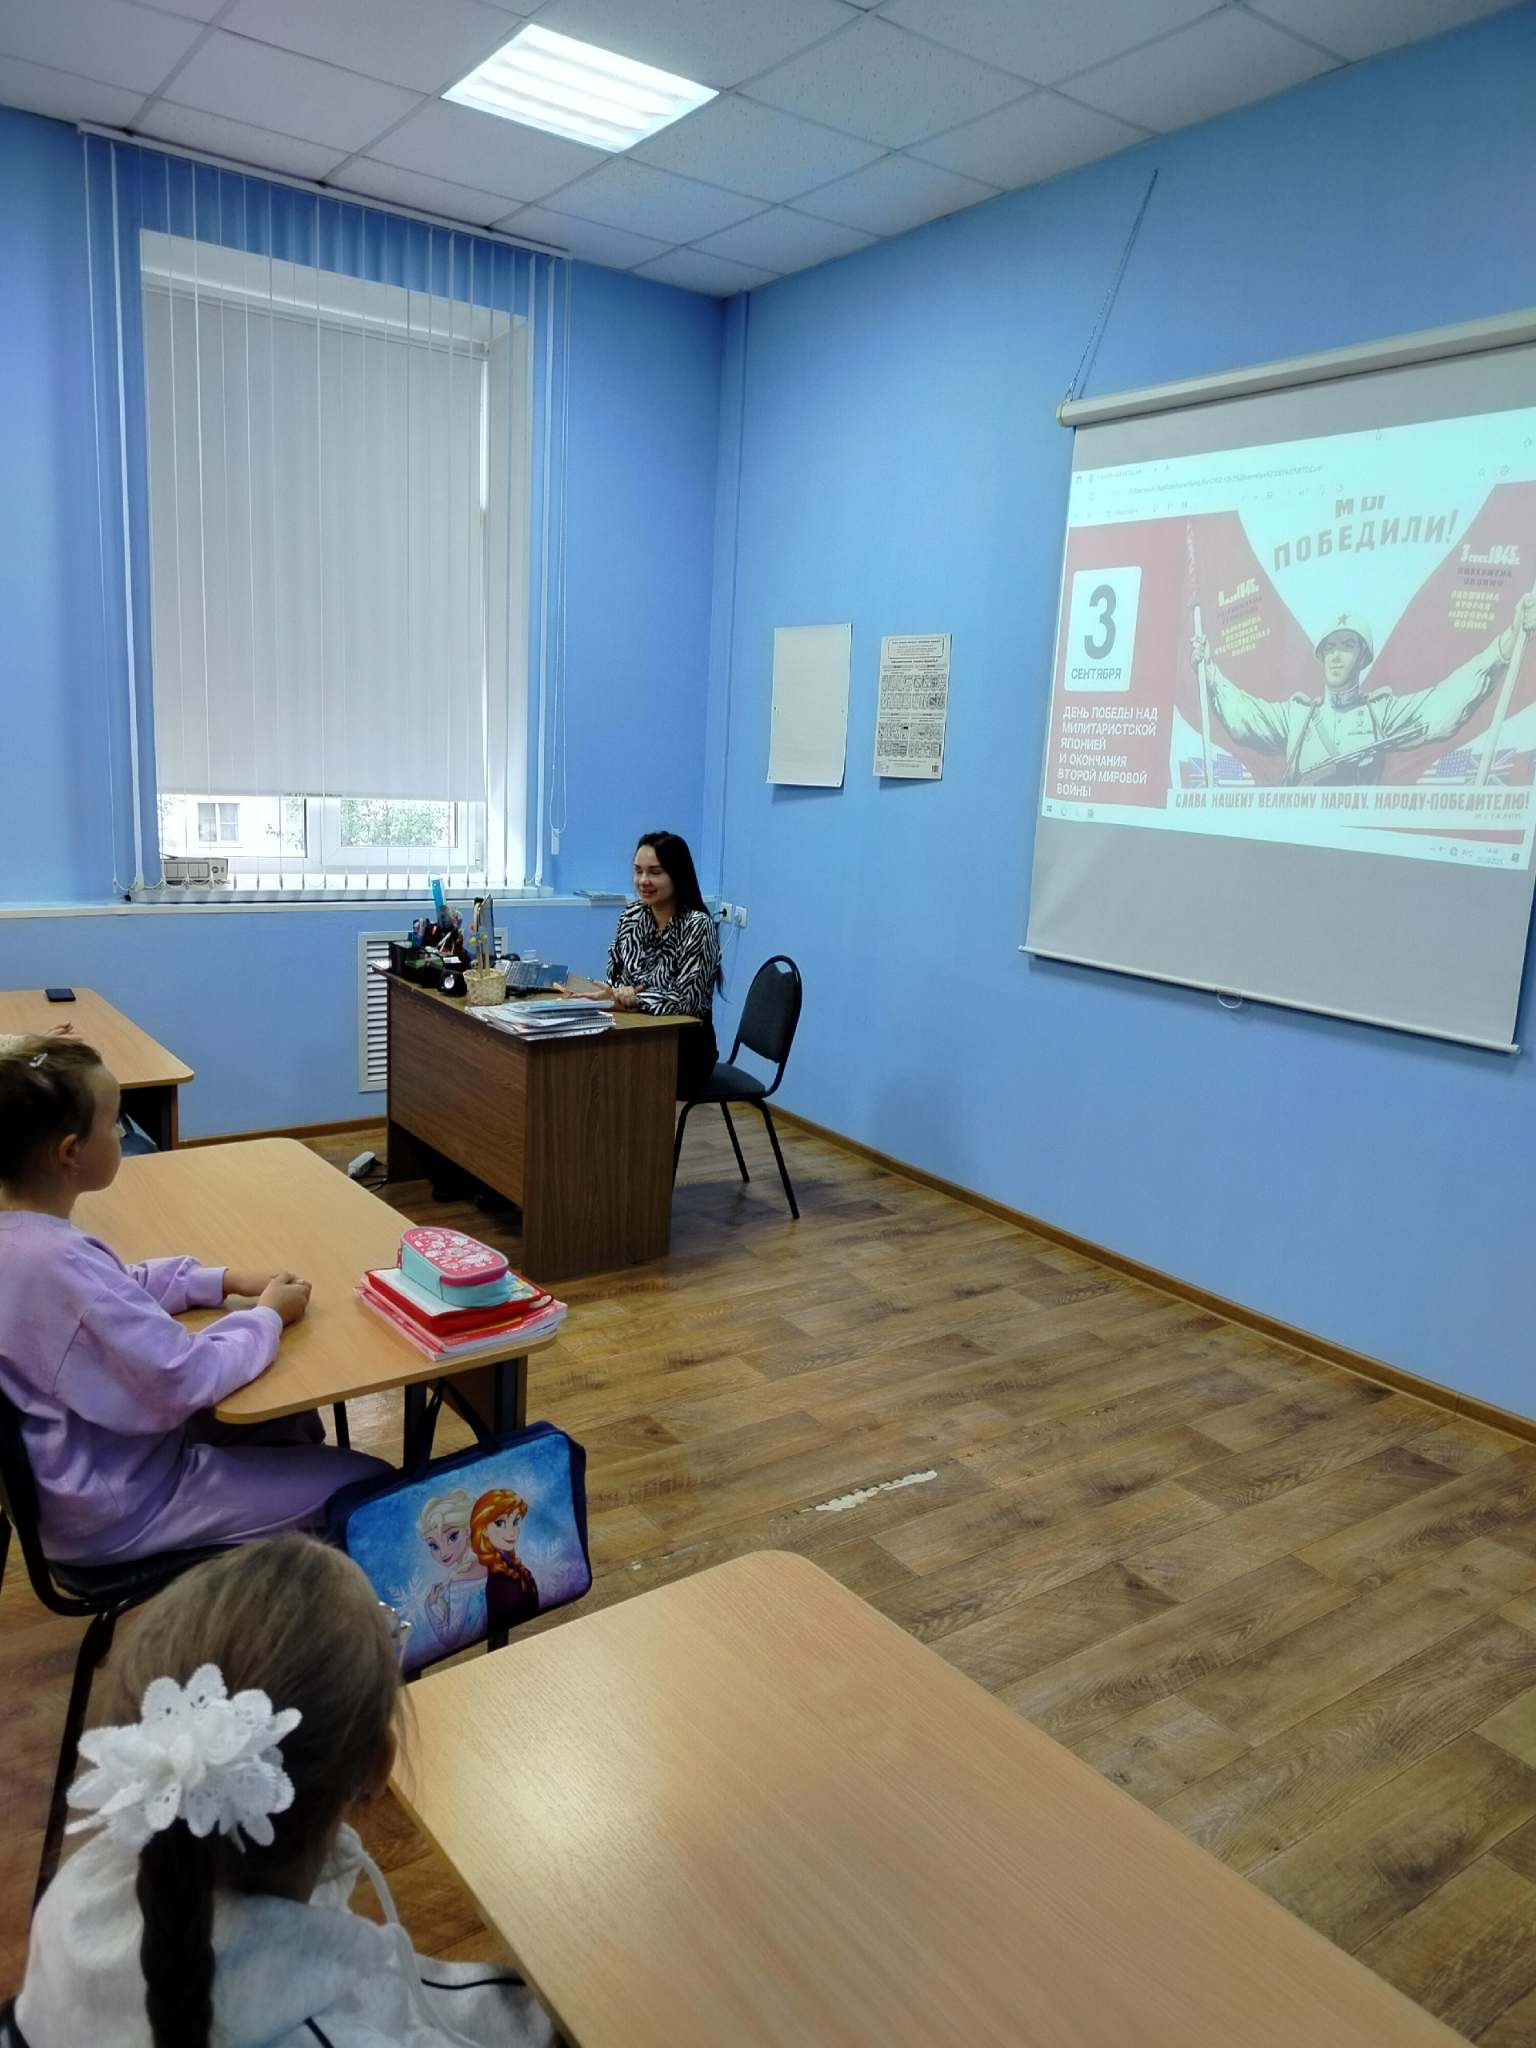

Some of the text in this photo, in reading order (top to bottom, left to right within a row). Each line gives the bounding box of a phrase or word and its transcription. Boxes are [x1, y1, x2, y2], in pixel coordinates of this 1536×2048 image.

[1335, 495, 1386, 519] МЫ
[1274, 508, 1459, 572] ПОБЕДИЛИ!
[1084, 584, 1117, 660] 3
[1071, 667, 1122, 681] СЕНТЯБРЯ
[1062, 706, 1159, 722] ДЕНЬ ПОБЕДЫ НАД
[1062, 721, 1157, 737] МИЛИТАРИСТСКОЙ
[1060, 736, 1106, 751] ЯПОНИЕЙ
[1059, 754, 1128, 767] И ОКОНЧАНИЯ
[1057, 768, 1148, 785] ВТОРОЙ МИРОВОЙ
[1056, 782, 1091, 797] ВОЙНЫ
[1175, 791, 1206, 808] СЛАВА
[1212, 791, 1254, 809] НАШЕМУ
[1258, 791, 1317, 809] ВЕЛИКОМУ
[1375, 791, 1530, 811] НАРОДУ-ПОБЕДИТЕЛЮ!
